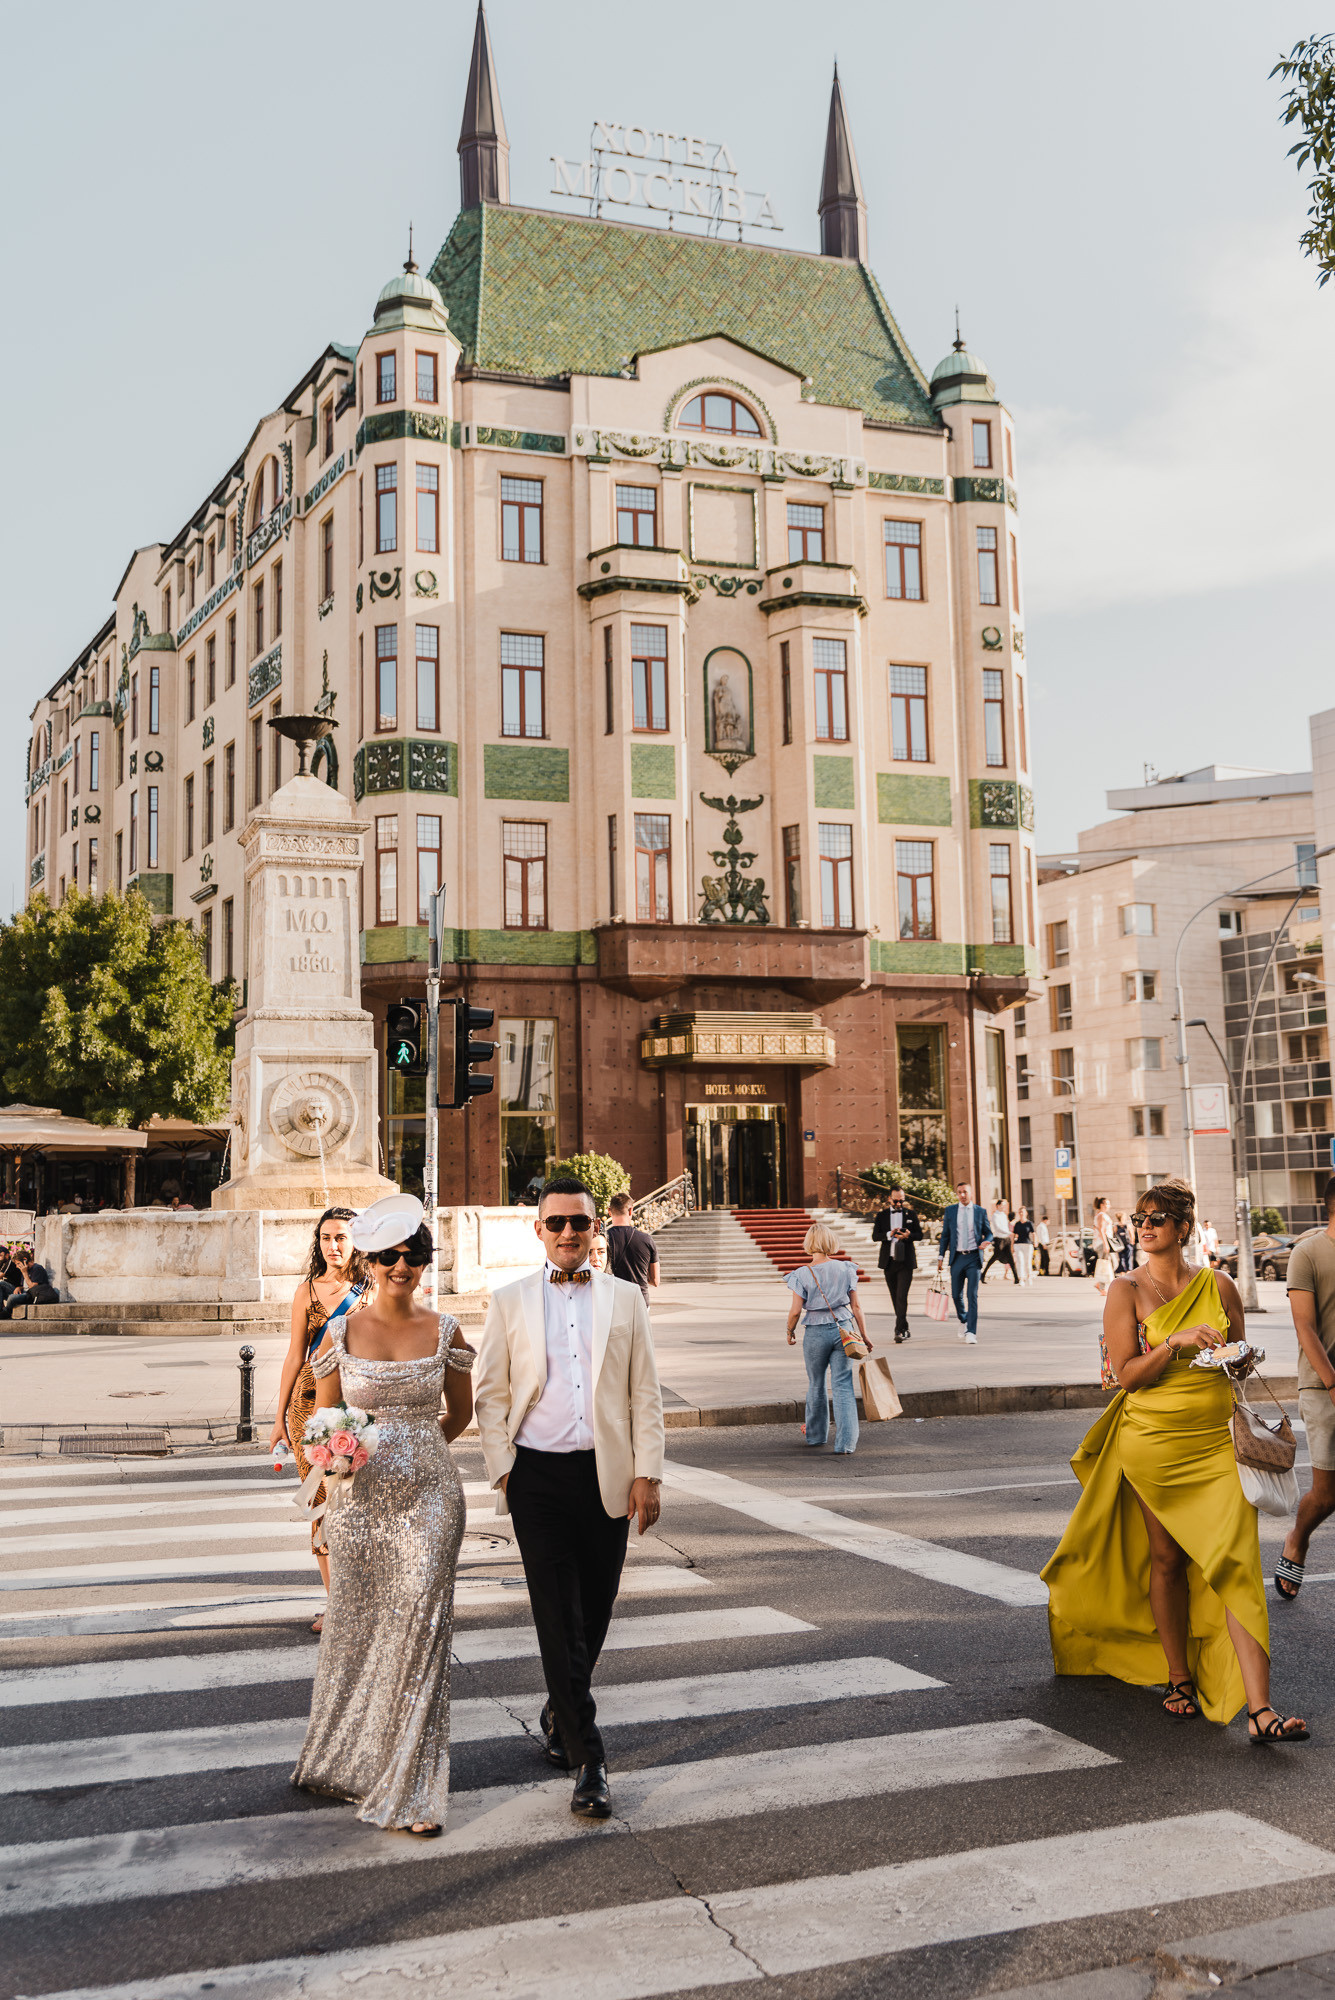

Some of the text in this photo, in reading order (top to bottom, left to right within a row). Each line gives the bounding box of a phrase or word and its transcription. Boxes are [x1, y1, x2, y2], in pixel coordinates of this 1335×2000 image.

[594, 120, 738, 174] ХОТЕЛ
[551, 154, 784, 231] МОСКВА
[705, 1084, 767, 1096] HOTEL MOSKVA
[1058, 1151, 1068, 1167] P
